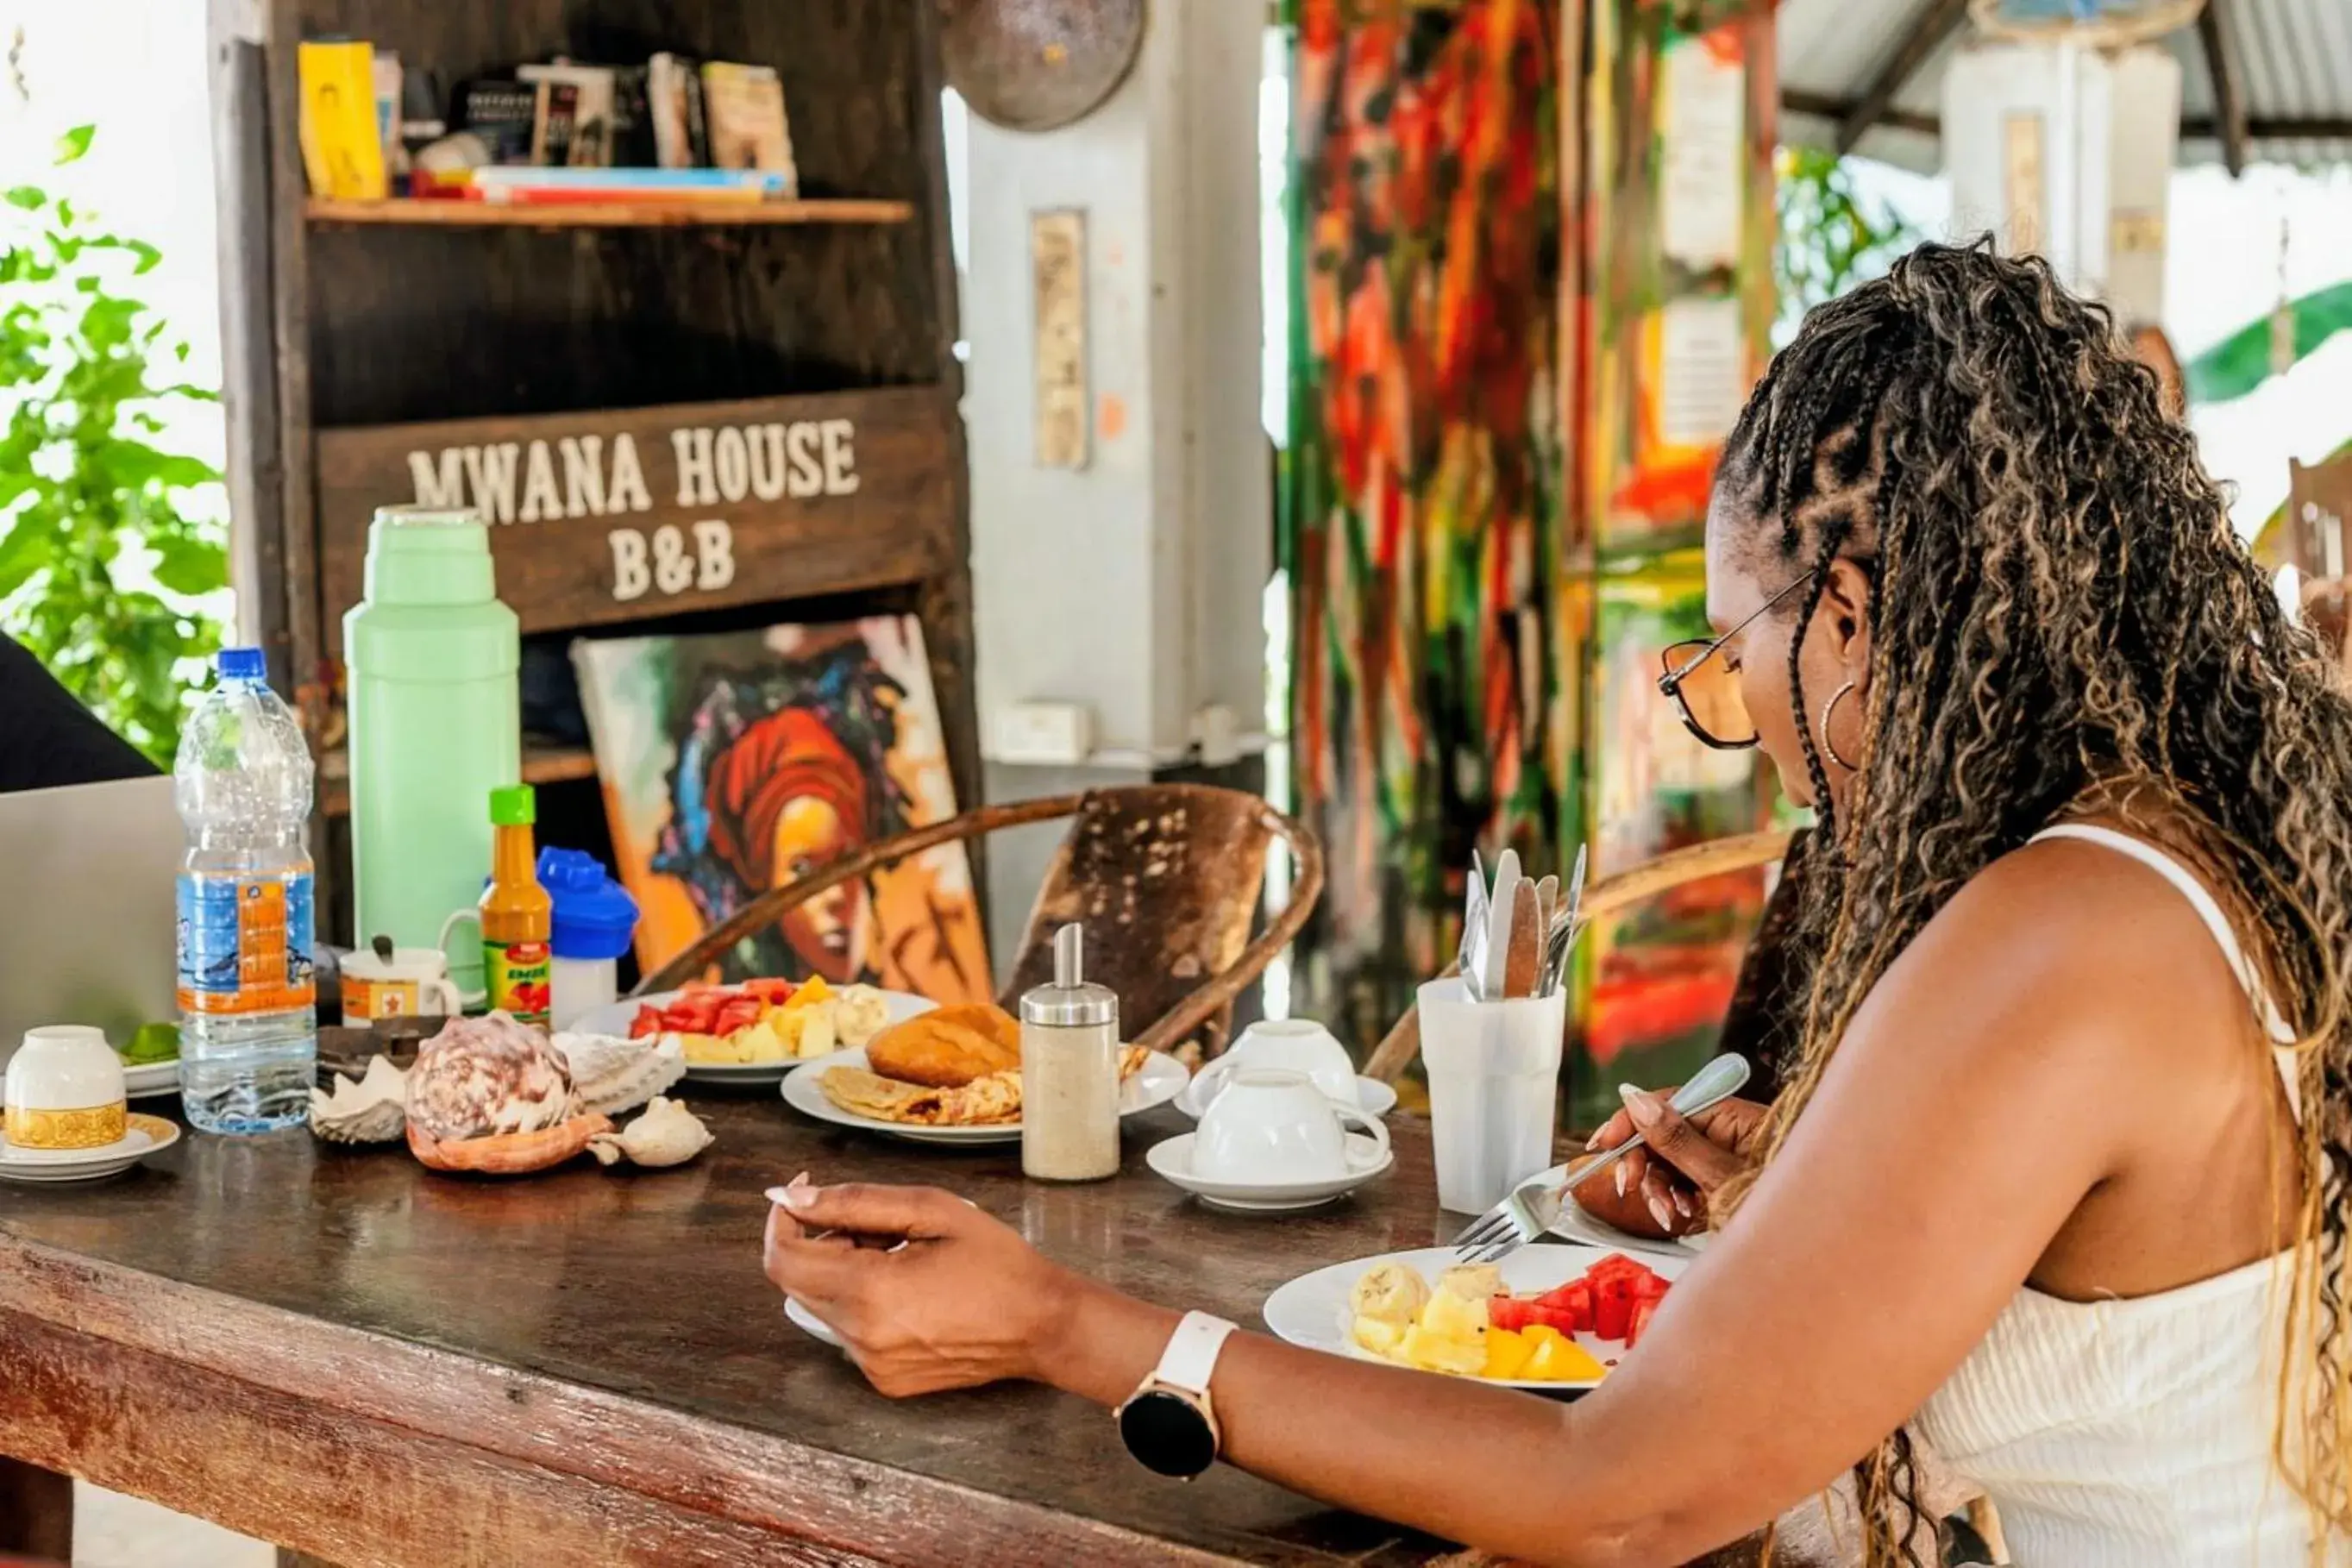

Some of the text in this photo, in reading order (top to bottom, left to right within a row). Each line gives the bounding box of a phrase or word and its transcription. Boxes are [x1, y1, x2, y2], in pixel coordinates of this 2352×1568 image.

[408, 419, 860, 525] MWANA HOUSE
[608, 519, 736, 601] B&B
